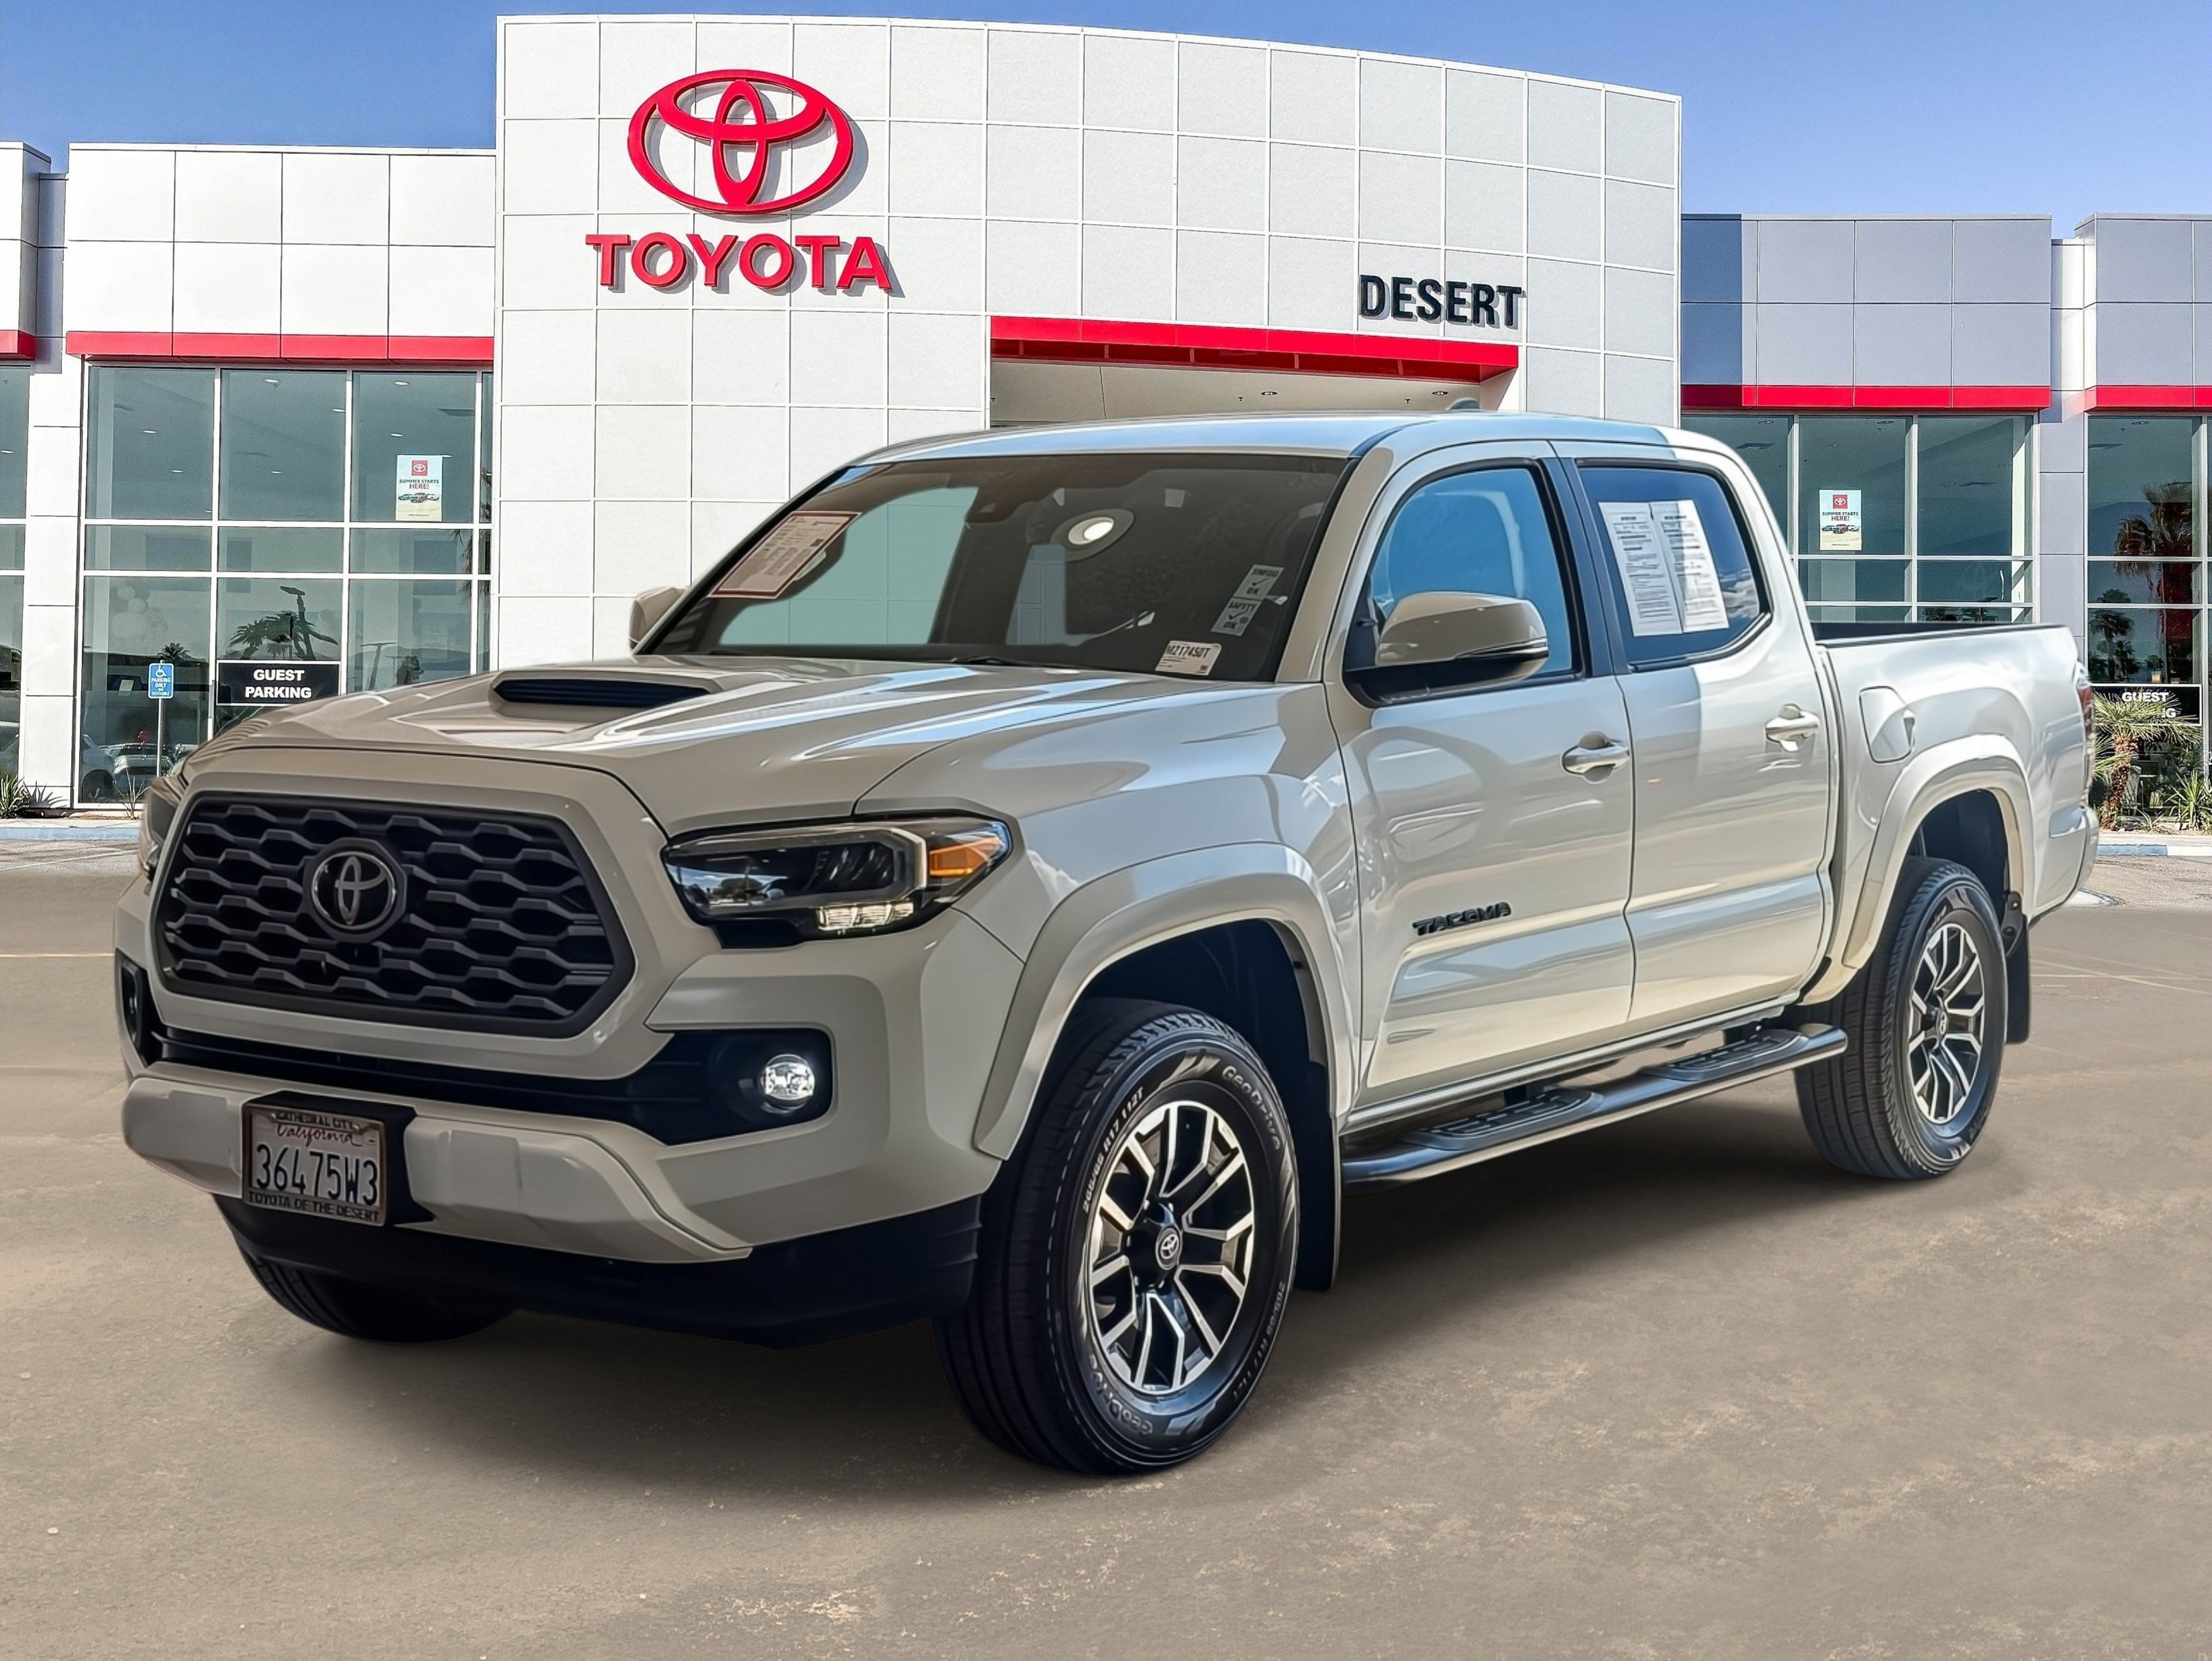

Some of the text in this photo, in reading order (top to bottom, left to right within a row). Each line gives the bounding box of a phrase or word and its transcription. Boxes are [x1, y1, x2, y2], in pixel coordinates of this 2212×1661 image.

[585, 232, 893, 291] TOYOTA
[1359, 274, 1522, 327] DESERT
[253, 669, 305, 681] GUEST
[245, 686, 312, 699] PARKING
[2121, 691, 2170, 703] GUEST
[1412, 901, 1512, 937] TACOMA
[275, 1110, 356, 1130] CATHEDRAL CITY
[276, 1123, 364, 1147] California
[256, 1143, 378, 1207] 36475W3
[248, 1191, 379, 1222] TOYOTA OF THE DESERT
